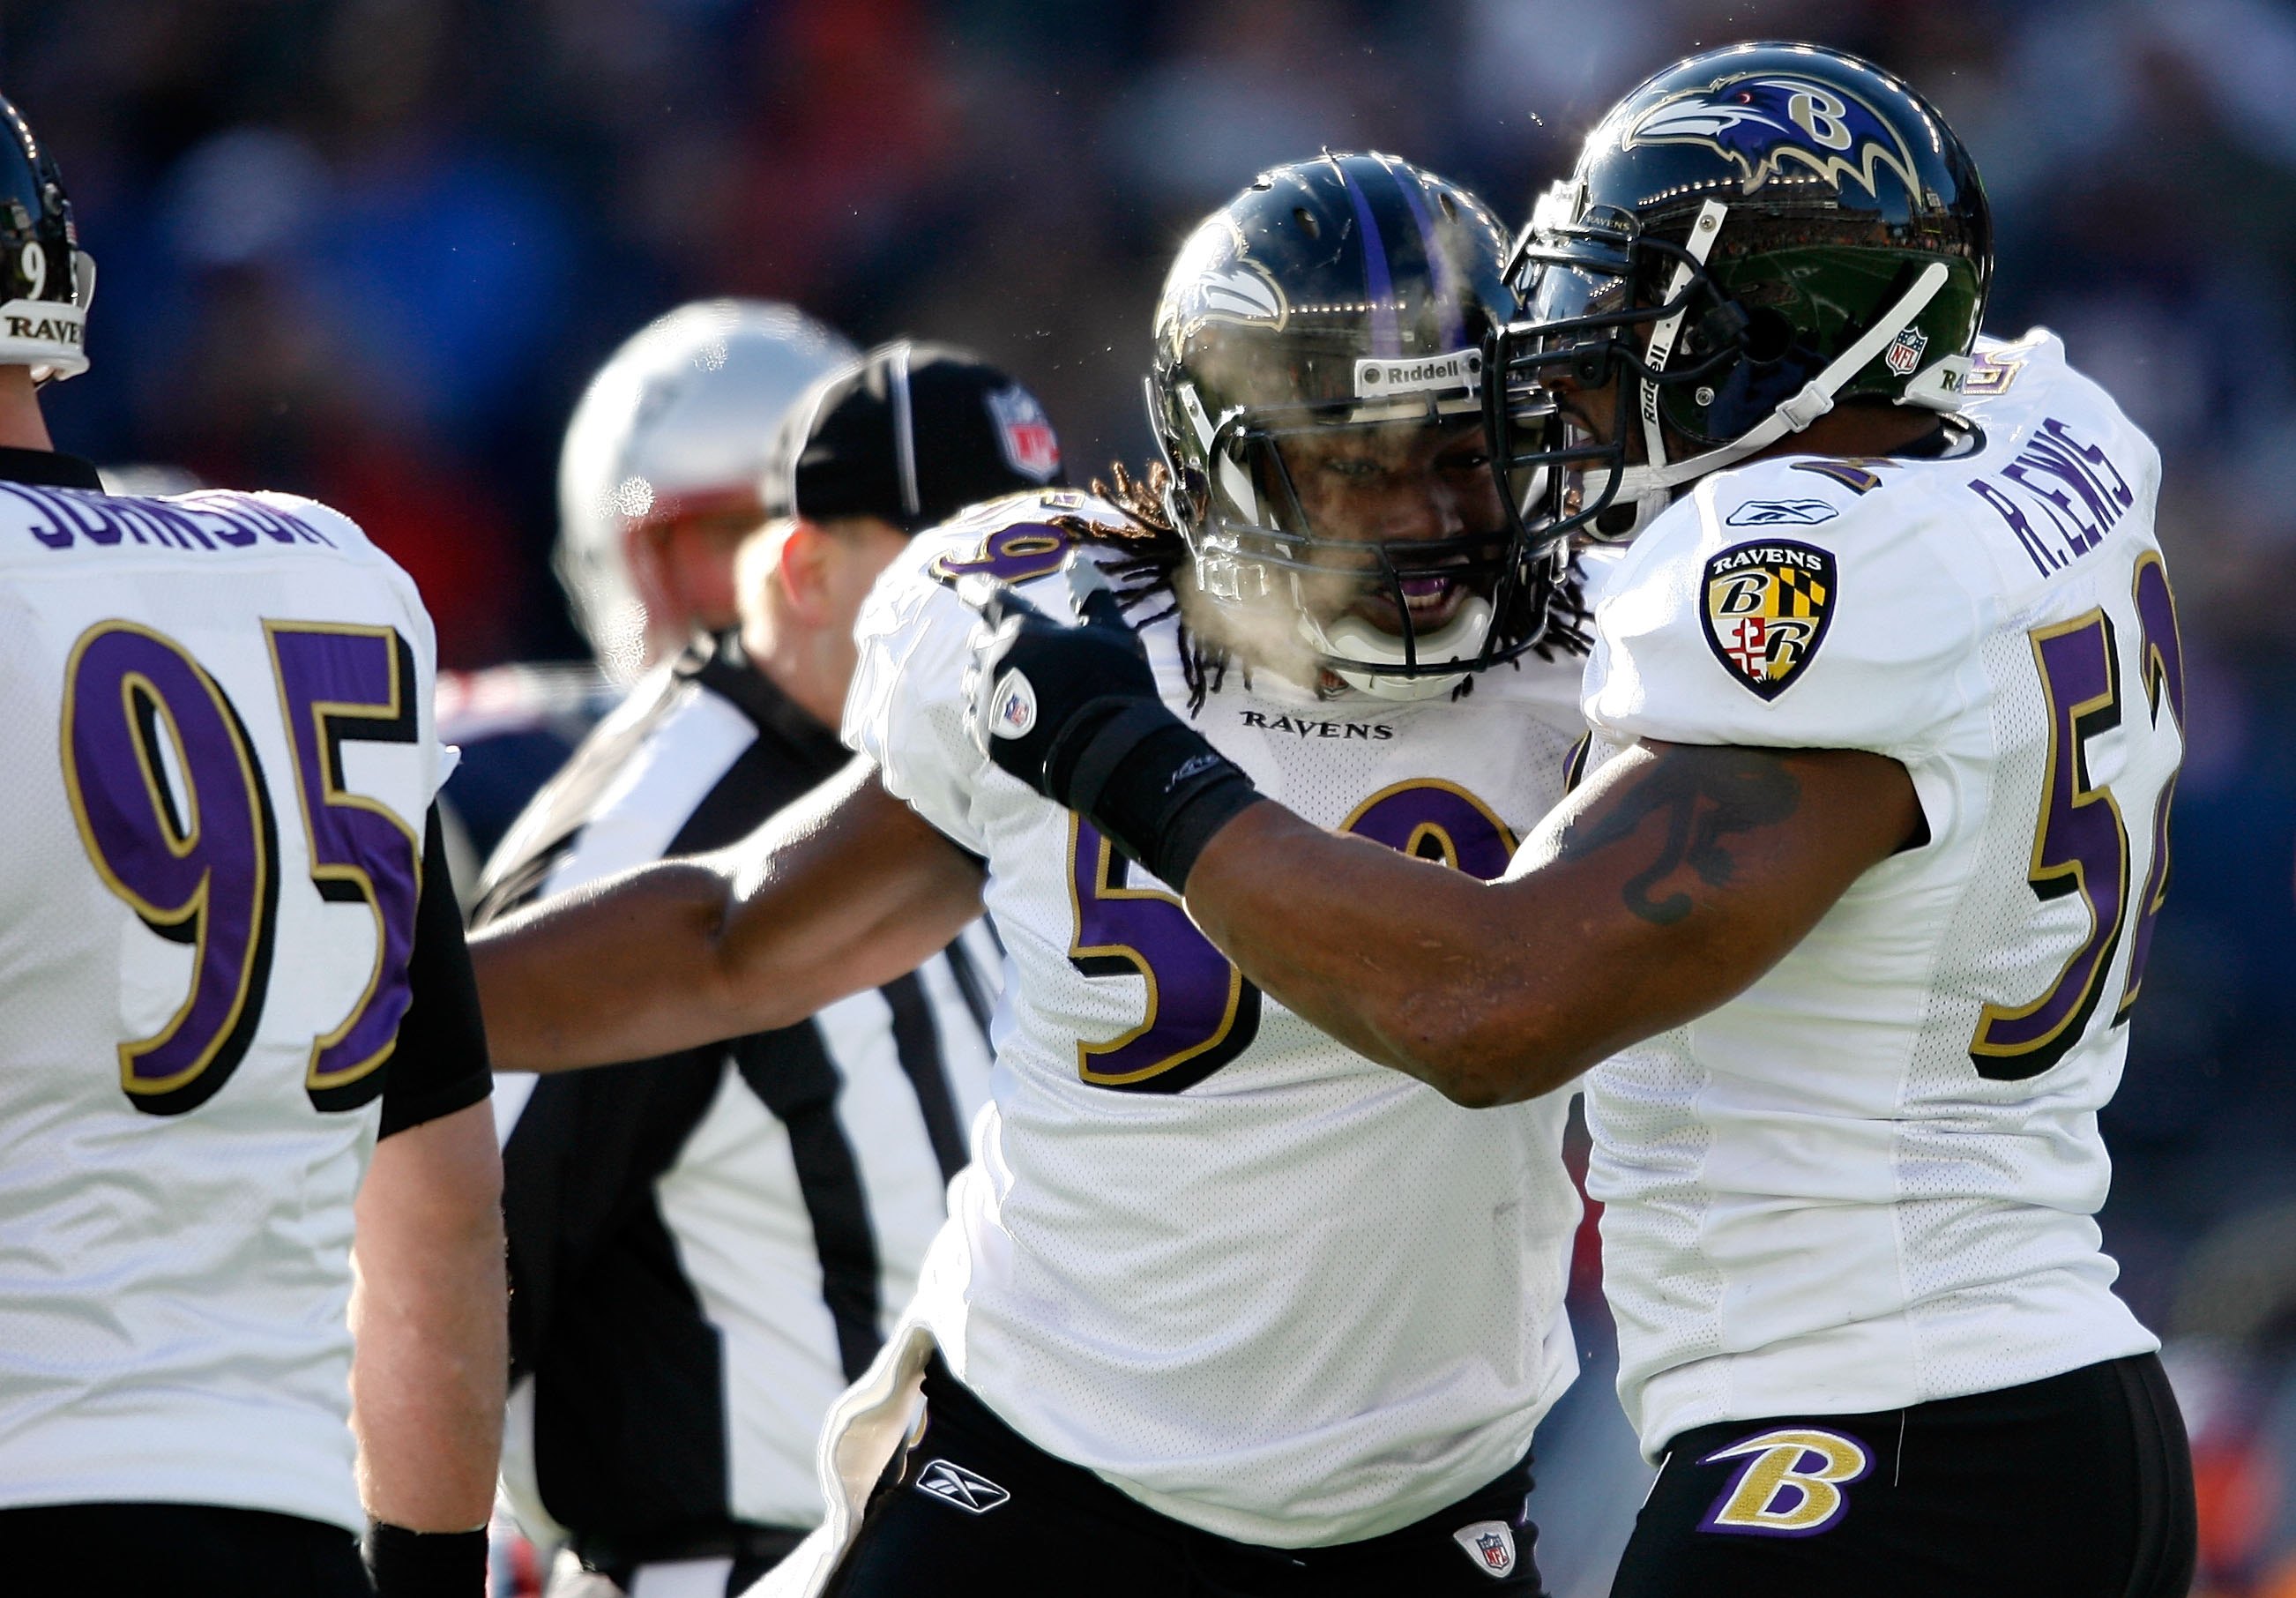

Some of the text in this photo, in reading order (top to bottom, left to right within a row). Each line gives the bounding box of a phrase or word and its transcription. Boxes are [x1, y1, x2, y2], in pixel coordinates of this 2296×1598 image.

[1752, 80, 1852, 151] B
[20, 240, 46, 301] 9
[5, 317, 84, 345] RAVE
[1388, 360, 1459, 385] Riddell
[1890, 345, 1916, 369] NFL
[1713, 549, 1823, 575] RAVENS
[1714, 571, 1770, 616] B
[1240, 711, 1393, 740] RAVENS
[59, 617, 423, 1116] 95
[1702, 1427, 1869, 1533] B
